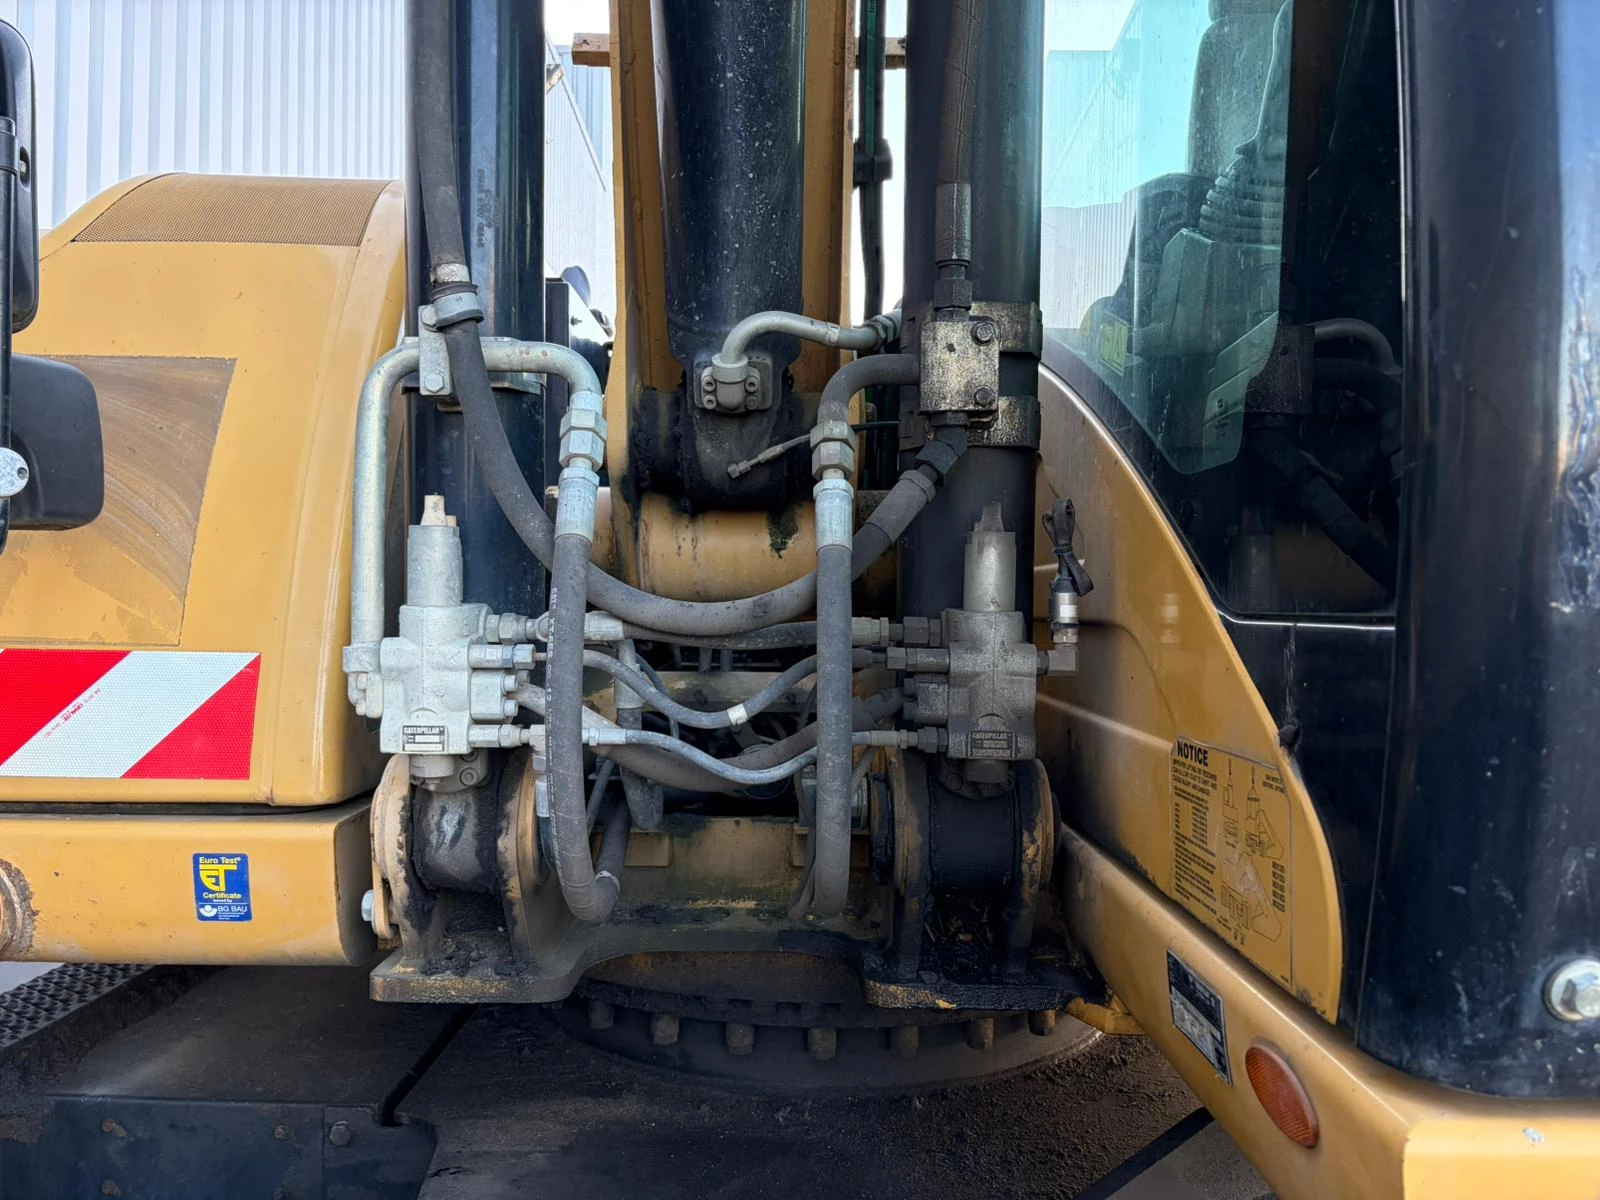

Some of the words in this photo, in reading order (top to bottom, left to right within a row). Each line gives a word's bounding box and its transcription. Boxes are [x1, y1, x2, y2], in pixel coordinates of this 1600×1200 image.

[1177, 741, 1209, 767] NOTICE
[199, 856, 218, 864] Euro
[231, 905, 248, 913] BAU
